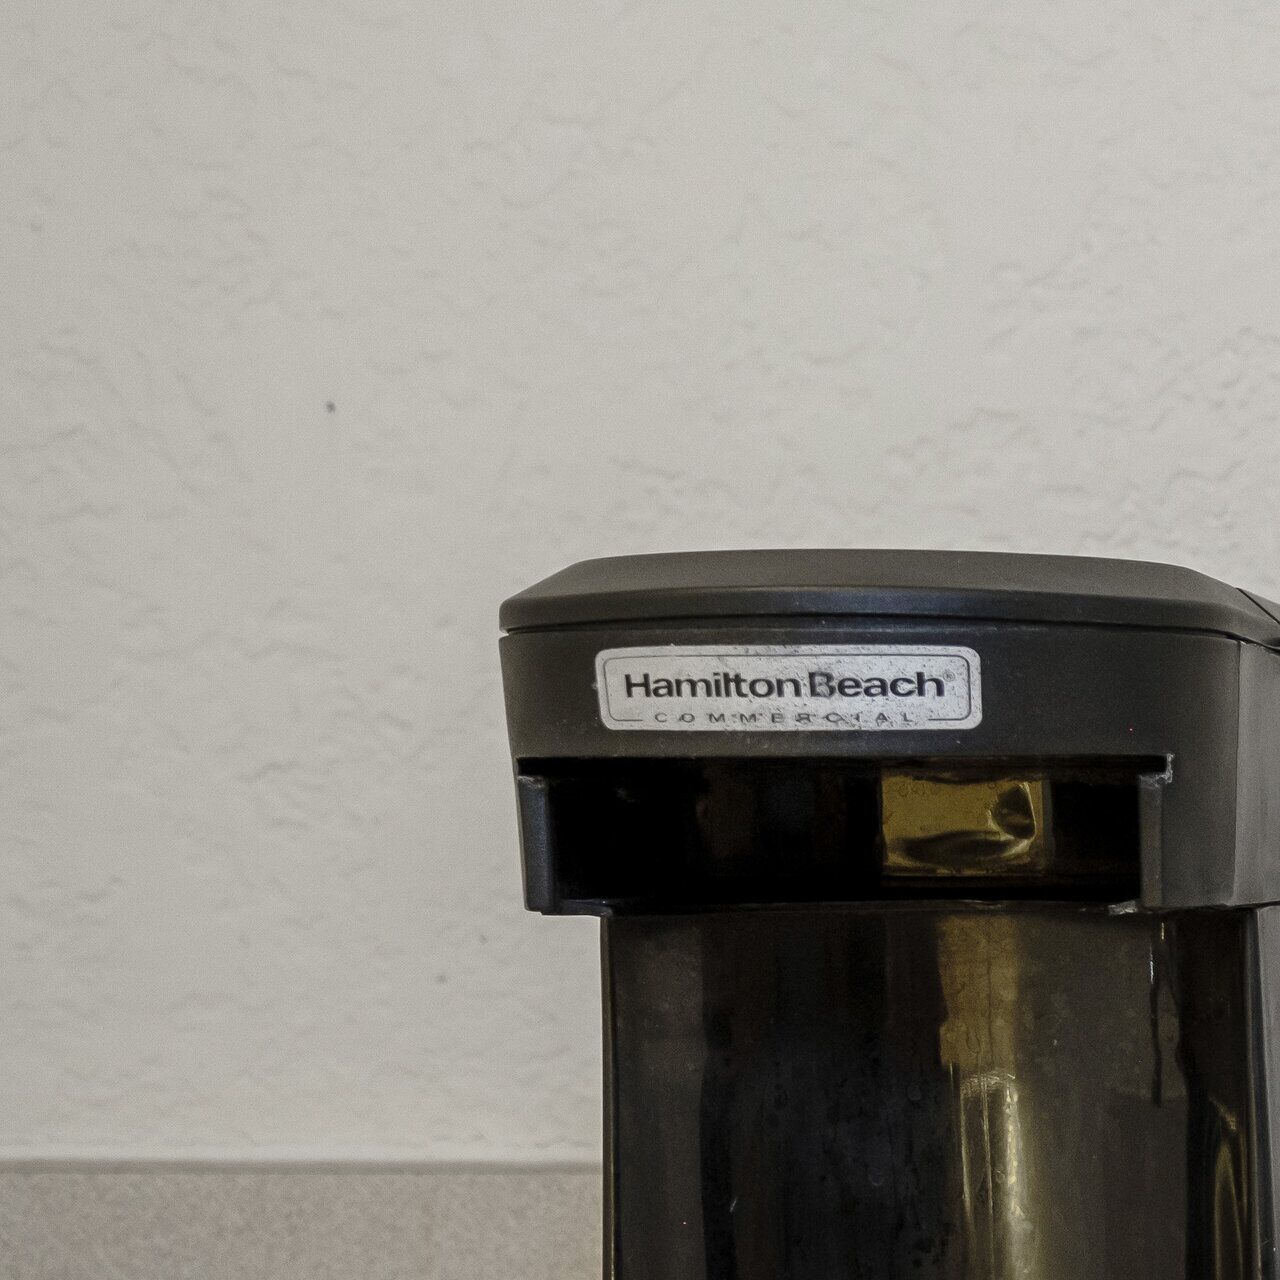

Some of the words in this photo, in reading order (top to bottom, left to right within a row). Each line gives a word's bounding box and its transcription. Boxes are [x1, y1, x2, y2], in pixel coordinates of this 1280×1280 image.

[625, 672, 799, 698] Hamilton
[808, 671, 945, 698] Beach
[654, 711, 915, 724] COMMERCIAL
